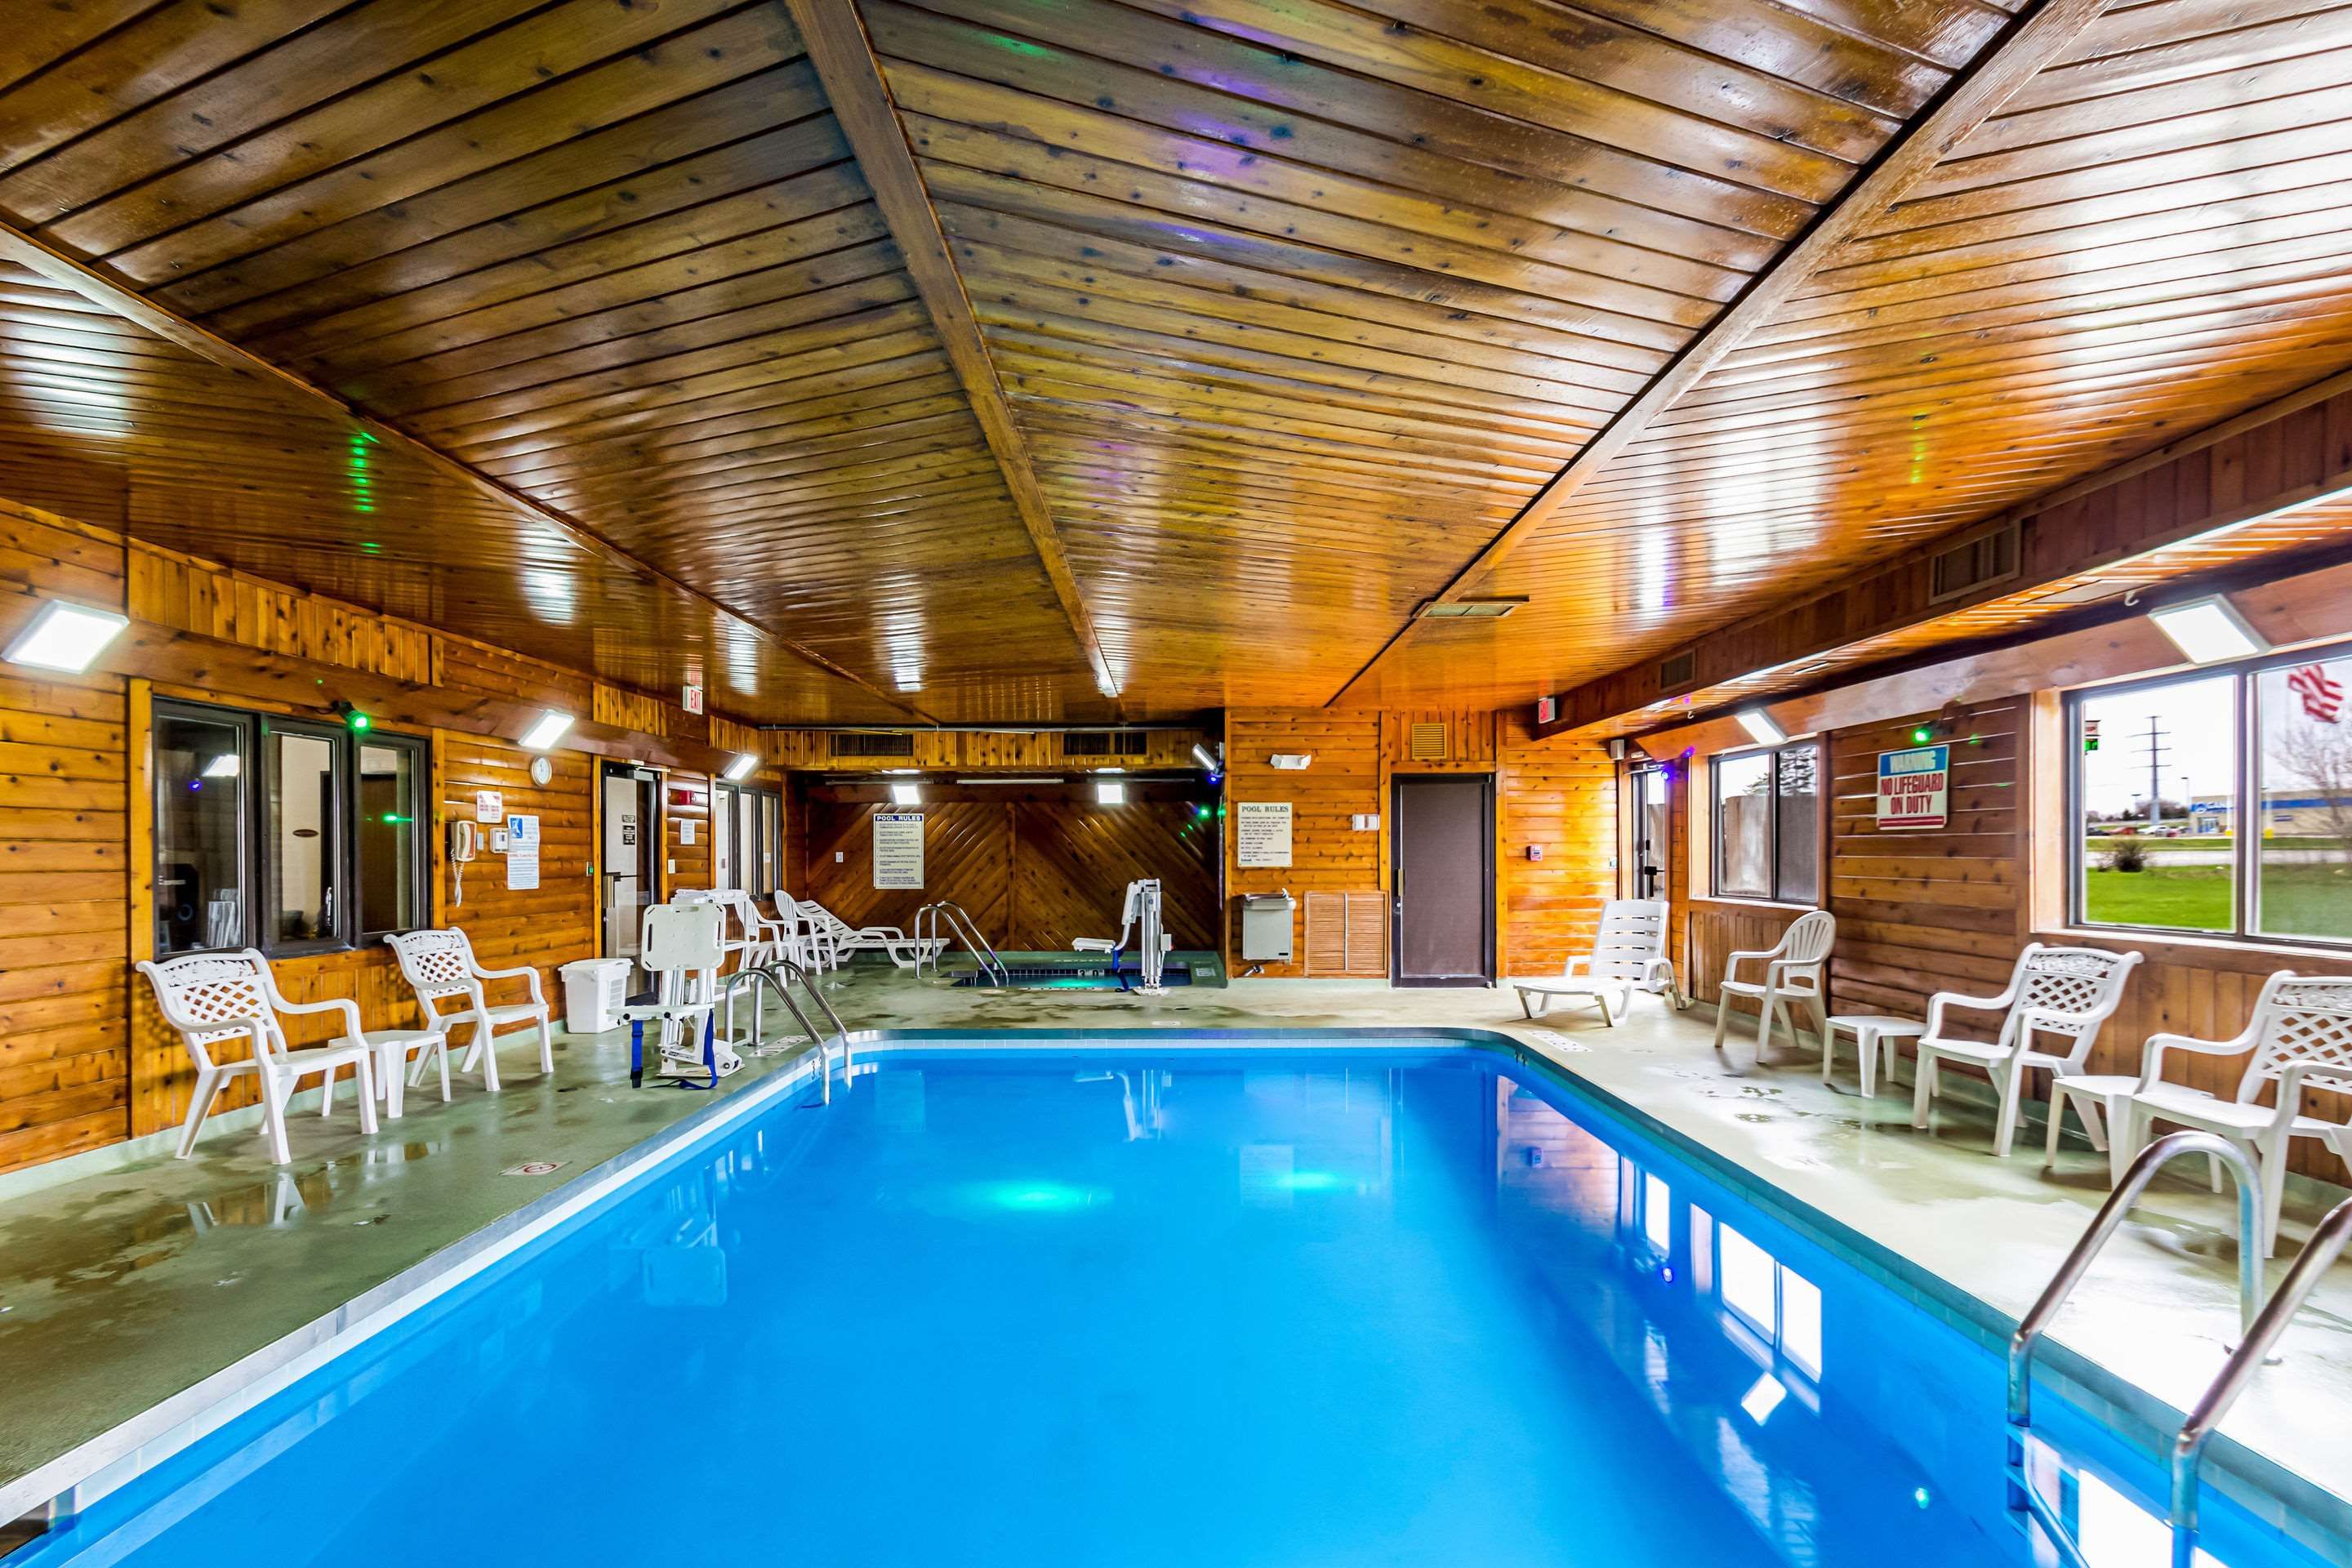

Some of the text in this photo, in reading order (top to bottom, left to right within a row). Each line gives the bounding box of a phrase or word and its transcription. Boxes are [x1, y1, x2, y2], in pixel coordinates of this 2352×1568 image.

[690, 689, 701, 710] EXIT
[1881, 773, 1944, 796] NO LIFEGUARD
[1891, 795, 1932, 815] ON DUTY
